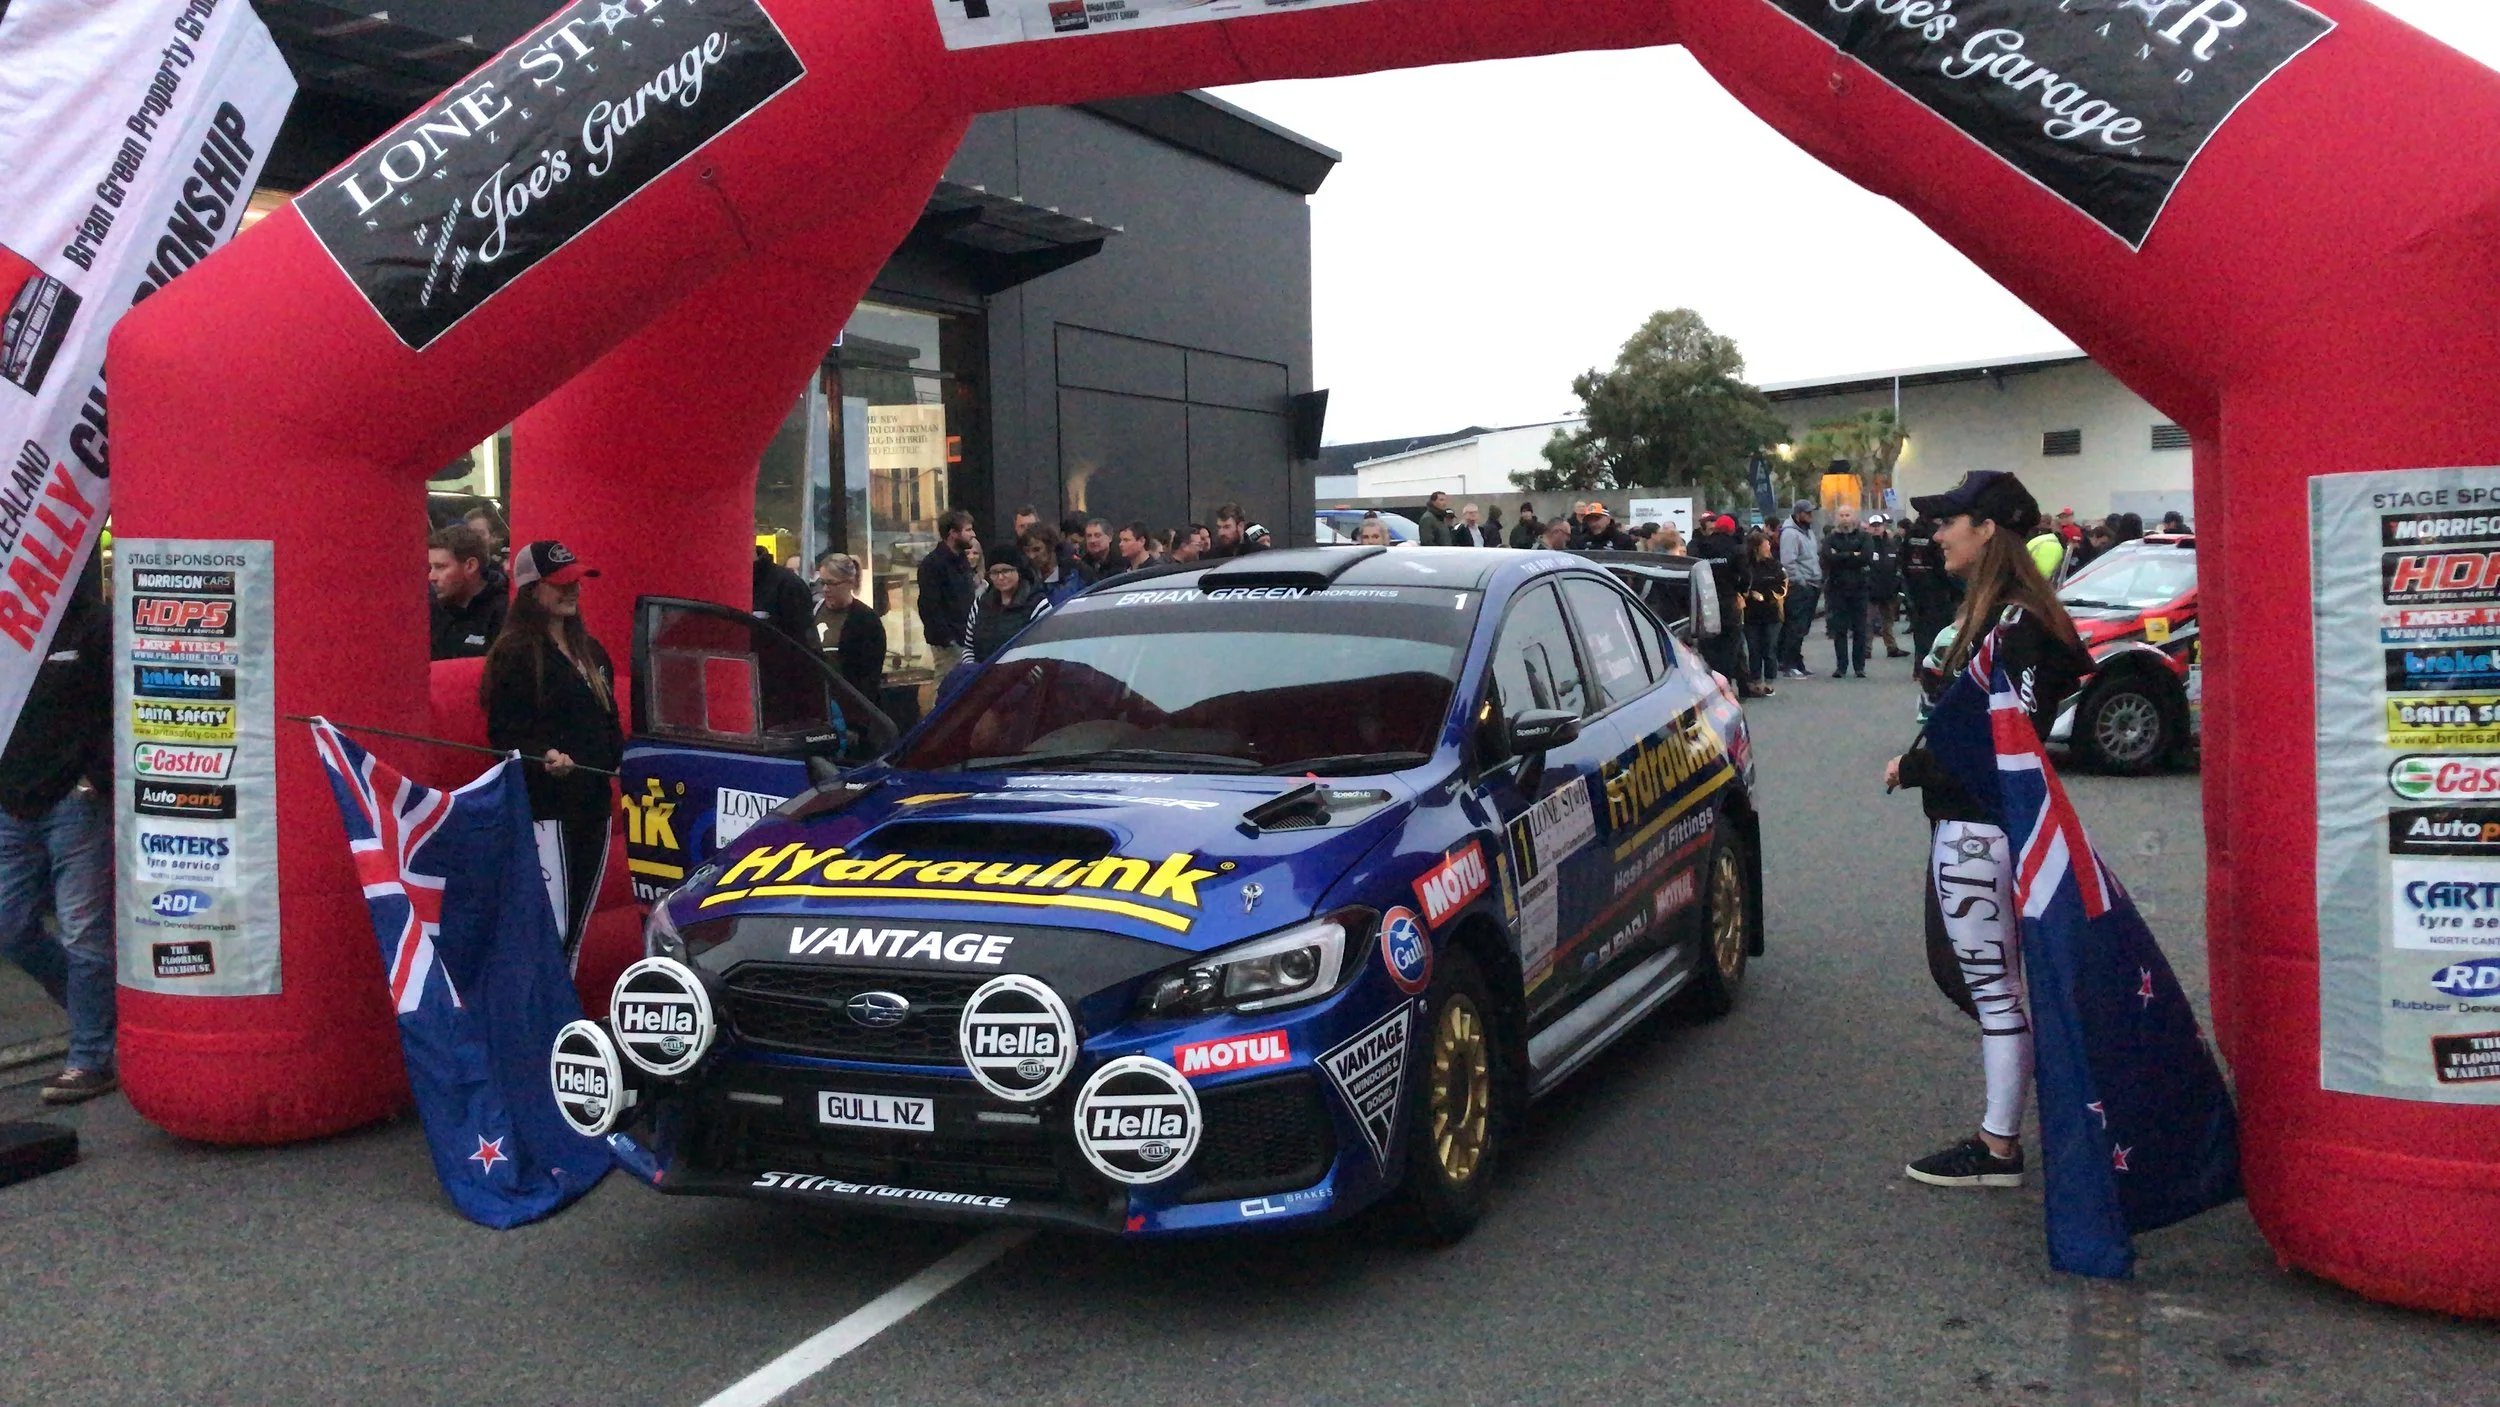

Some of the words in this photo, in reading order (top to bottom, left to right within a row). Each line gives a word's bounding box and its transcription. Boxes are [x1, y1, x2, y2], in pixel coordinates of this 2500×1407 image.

[1940, 28, 2145, 147] Garage
[62, 208, 116, 272] Brian
[95, 136, 147, 207] Green
[125, 46, 196, 143] Property
[338, 81, 513, 216] LONE
[471, 148, 573, 264] Joe's
[581, 31, 728, 177] Garage
[412, 222, 429, 246] in
[420, 197, 463, 307] association
[449, 244, 471, 294] with
[883, 423, 939, 434] COUNTRYMAN
[2373, 489, 2449, 509] STAGE
[0, 461, 95, 653] RALLY
[128, 553, 160, 566] STAGE
[165, 554, 246, 567] SPONSORS
[137, 573, 203, 589] MORRISON
[202, 575, 231, 586] CARS
[1115, 588, 1203, 607] BRIAN
[1207, 586, 1309, 602] GREEN
[1309, 588, 1400, 599] PROPERTIES
[1454, 593, 1468, 611] 1
[135, 598, 232, 629] HDPS
[2406, 610, 2476, 626] MRF
[179, 640, 221, 653] TYRES
[176, 708, 226, 723] SAFETY
[2400, 705, 2471, 723] BRITA
[1516, 726, 1551, 737] Speedhub
[153, 749, 223, 774] Castrol
[142, 787, 223, 807] Autoparts
[1332, 789, 1372, 799] Speedhub
[1530, 797, 1563, 838] LONE
[1613, 857, 1643, 897] Hose
[1668, 804, 1714, 847] Fittings
[146, 857, 167, 868] tyre
[171, 859, 221, 872] service
[716, 842, 1218, 907] Hydraulink
[1422, 848, 1487, 921] MOTUL
[1655, 872, 1695, 913] MOTUL
[151, 893, 208, 913] RDL
[2419, 913, 2463, 929] tyre
[170, 944, 190, 955] THE
[789, 927, 1014, 964] VANTAGE
[1393, 937, 1425, 971] Gull
[2430, 936, 2469, 945] NORTH
[157, 963, 211, 975] WAREHOUSE
[160, 954, 204, 965] FLOORING
[624, 1004, 693, 1033] Hella
[2392, 999, 2451, 1012] Rubber
[975, 1026, 1055, 1055] Hella
[1183, 1036, 1285, 1072] MOTUL
[1335, 1020, 1405, 1081] VANTAGE
[559, 1064, 606, 1096] Hella
[1018, 1063, 1047, 1076] HELLA
[1352, 1062, 1394, 1095] WINDOWS
[827, 1096, 888, 1123] GULL
[893, 1100, 926, 1126] NZ
[1366, 1084, 1393, 1113] DOORS
[1093, 1108, 1182, 1138] Hella
[1139, 1144, 1171, 1157] HELLA
[1240, 1198, 1286, 1217] CL
[1286, 1186, 1334, 1203] BRAKES
